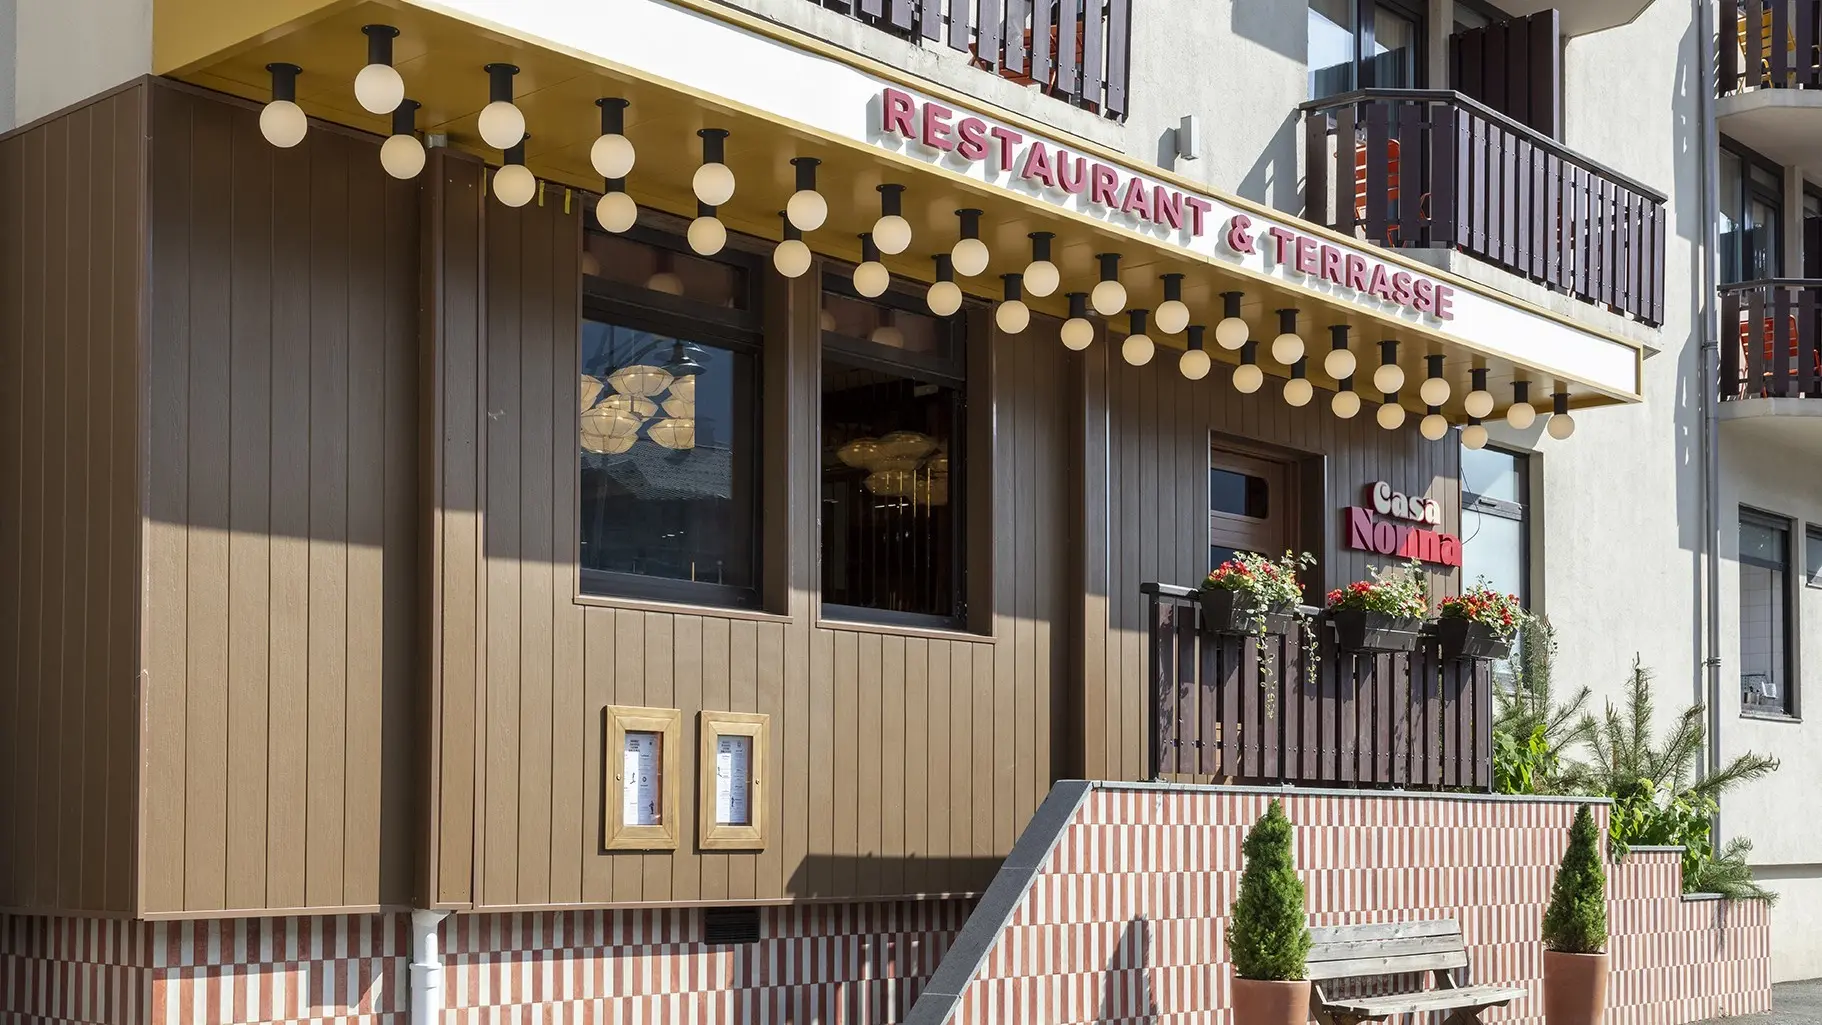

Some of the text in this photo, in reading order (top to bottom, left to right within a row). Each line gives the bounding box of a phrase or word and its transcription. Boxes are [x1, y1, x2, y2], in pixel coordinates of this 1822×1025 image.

[883, 87, 1454, 321] RESTAURANT & TERRASSE
[1368, 481, 1441, 525] Casa
[1348, 505, 1463, 568] Nonna
